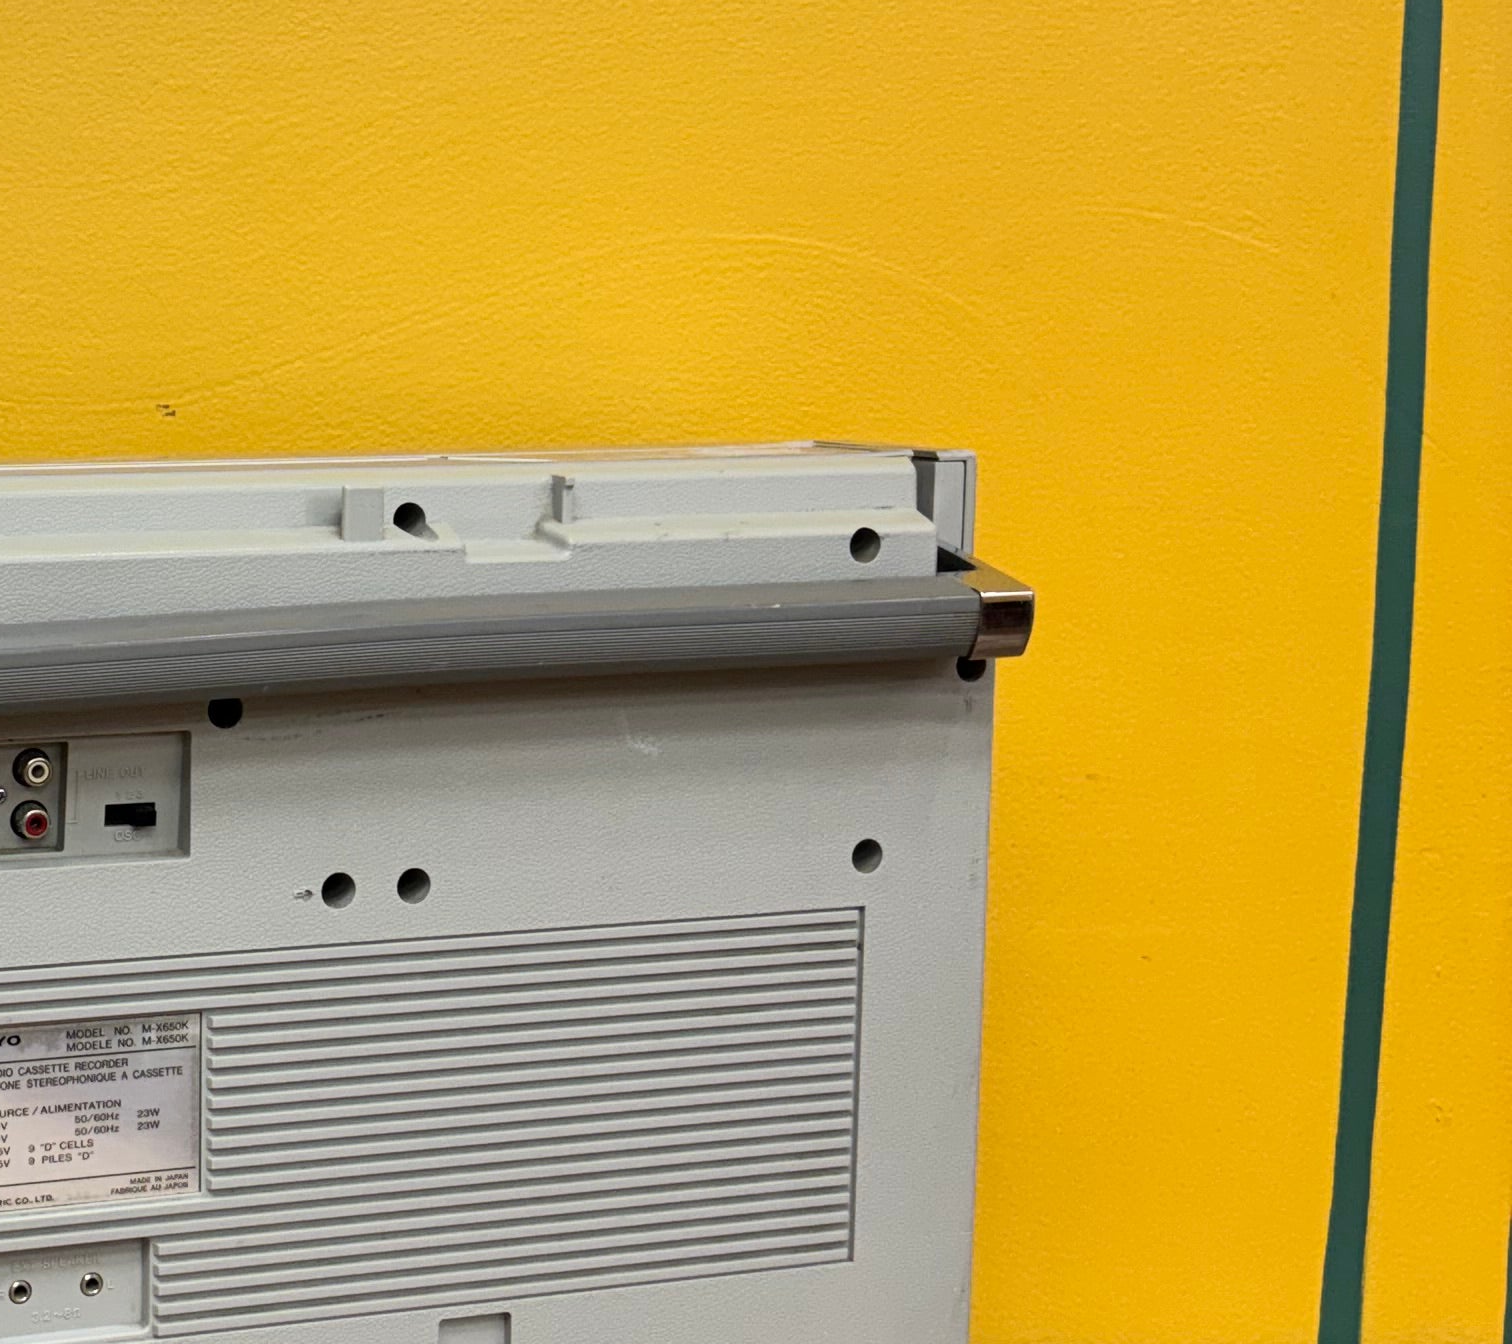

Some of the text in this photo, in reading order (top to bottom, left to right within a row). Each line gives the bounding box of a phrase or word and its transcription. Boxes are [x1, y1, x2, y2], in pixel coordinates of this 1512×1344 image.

[66, 1027, 105, 1040] MODEL
[141, 1020, 189, 1034] M-X650K
[66, 1038, 112, 1053] MODELE
[141, 1032, 189, 1046] M-X650K
[17, 1062, 71, 1077] CASSETTE
[74, 1057, 129, 1072] RECORDER
[26, 1071, 117, 1090] STEREOPHONIQUE
[132, 1065, 184, 1080] CASSETTE
[74, 1112, 121, 1125] 50/60Hz
[136, 1107, 161, 1119] 23W
[74, 1124, 121, 1137] 50/60Hz
[136, 1119, 161, 1131] 23W
[59, 1138, 95, 1151] CELLS
[41, 1152, 73, 1165] PILES
